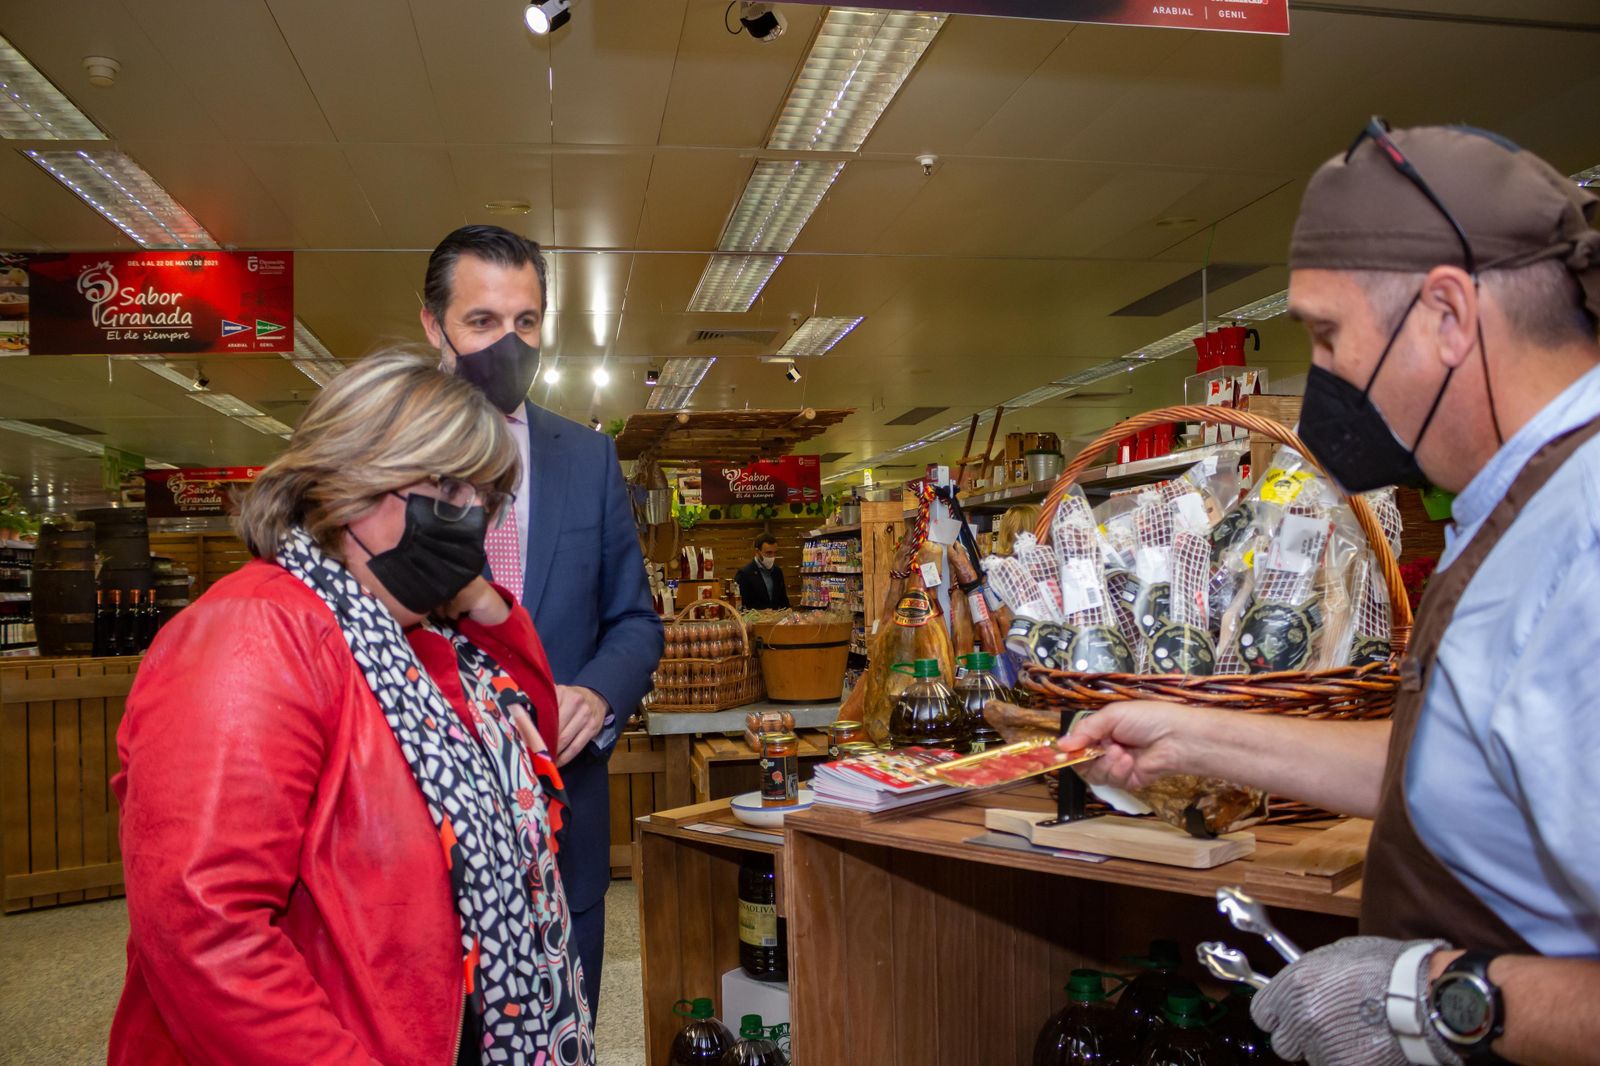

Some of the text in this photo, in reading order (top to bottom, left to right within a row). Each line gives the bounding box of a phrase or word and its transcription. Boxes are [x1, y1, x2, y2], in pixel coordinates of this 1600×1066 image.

[1152, 6, 1247, 19] ARABIAL GENIL
[119, 286, 183, 306] Sabor
[101, 306, 193, 327] Granada
[106, 330, 191, 343] El de siempre
[741, 472, 770, 482] Sabor
[733, 481, 775, 492] Granada
[178, 494, 222, 505] Granada
